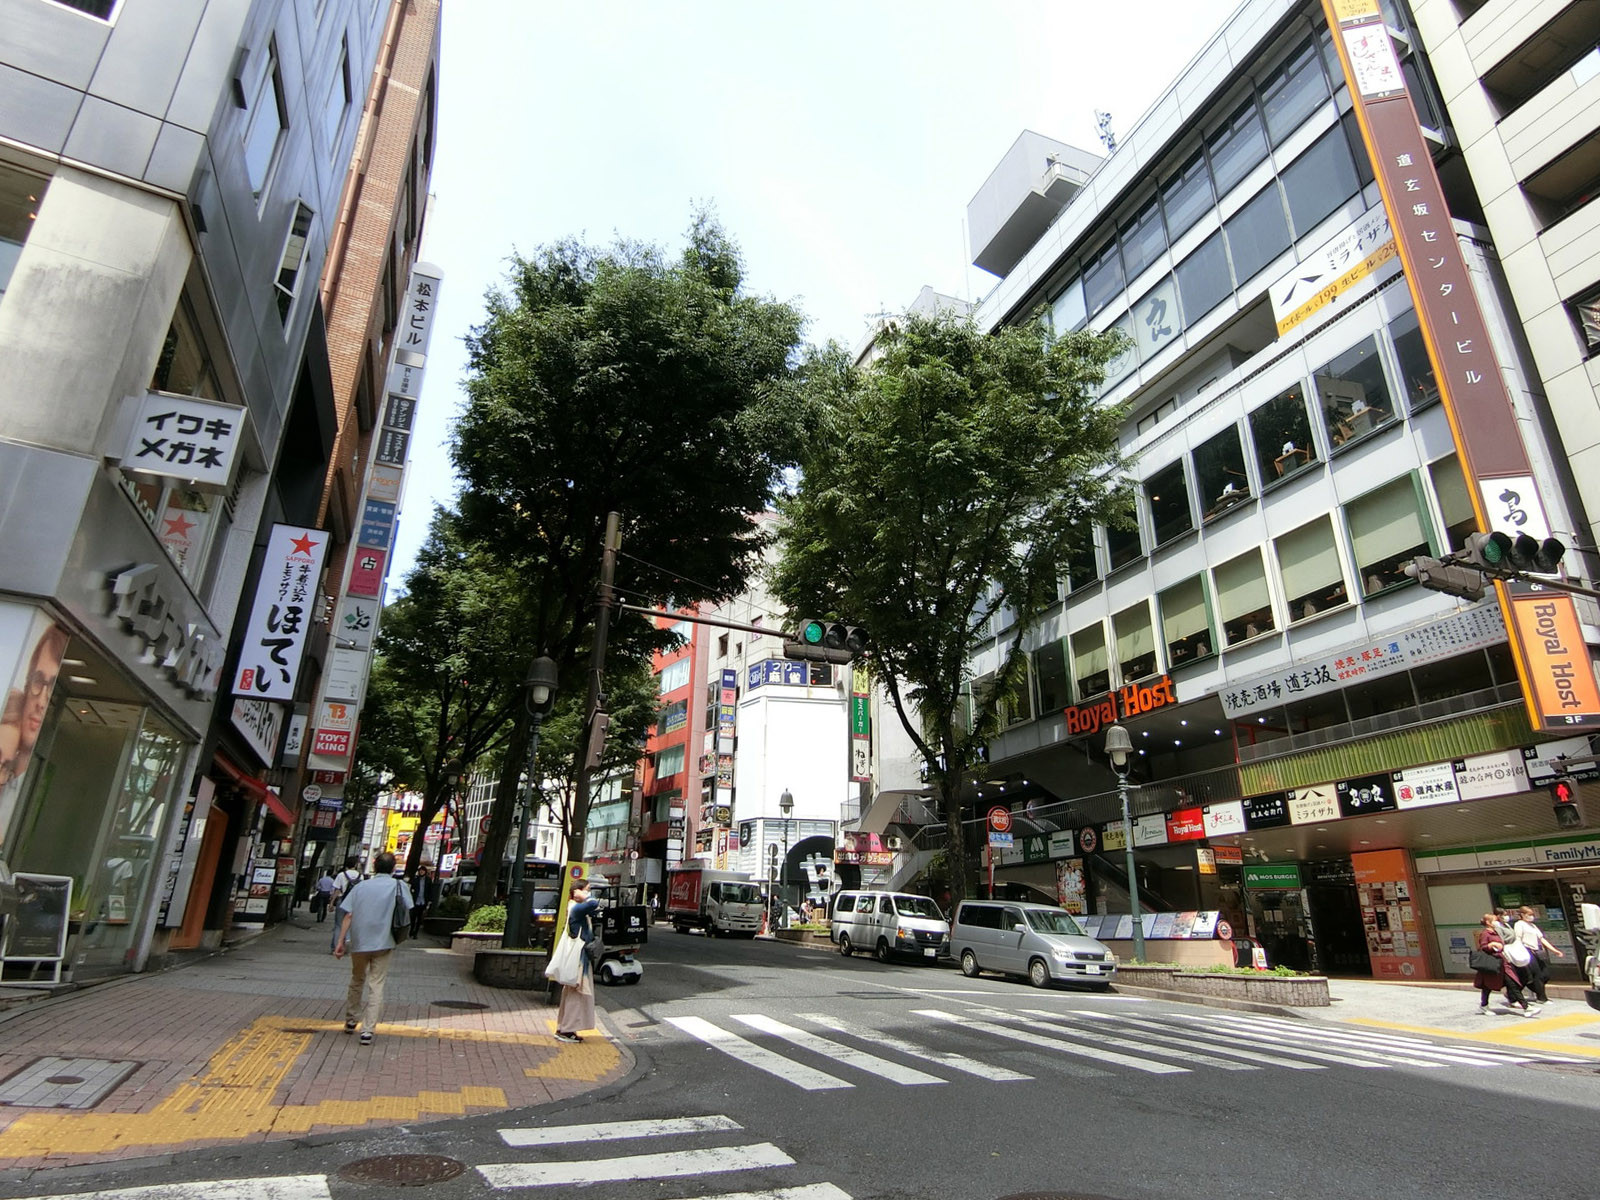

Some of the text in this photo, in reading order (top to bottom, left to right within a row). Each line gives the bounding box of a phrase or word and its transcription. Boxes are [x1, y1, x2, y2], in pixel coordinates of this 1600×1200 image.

[1396, 154, 1482, 385] 道玄坂センタービル
[1282, 305, 1313, 329] ハイボール
[1341, 260, 1376, 288] 生ビール
[406, 282, 432, 345] 松本ビル
[147, 411, 233, 442] イワキ
[136, 437, 225, 469] メガネ
[285, 555, 316, 564] SAPPORO
[362, 556, 377, 571] 占
[279, 562, 294, 602] レモンサワー
[291, 564, 312, 603] 牛煮込み
[255, 604, 303, 693] ほてい
[1534, 602, 1582, 709] Royal Host
[1225, 680, 1282, 711] 焼売酒場
[1285, 664, 1337, 694] 道玄坂
[857, 698, 865, 732] モスバーガー
[1064, 674, 1176, 735] Royal Host
[1565, 715, 1584, 724] 3F
[317, 743, 346, 752] KING
[318, 732, 348, 743] TOY'S
[1455, 762, 1465, 770] 7F
[1524, 749, 1536, 758] 8F
[1296, 806, 1334, 820] ミライザカ
[1173, 824, 1189, 836] Royal
[1189, 822, 1203, 832] Host
[1484, 857, 1532, 866] 道玄坂センタービル店
